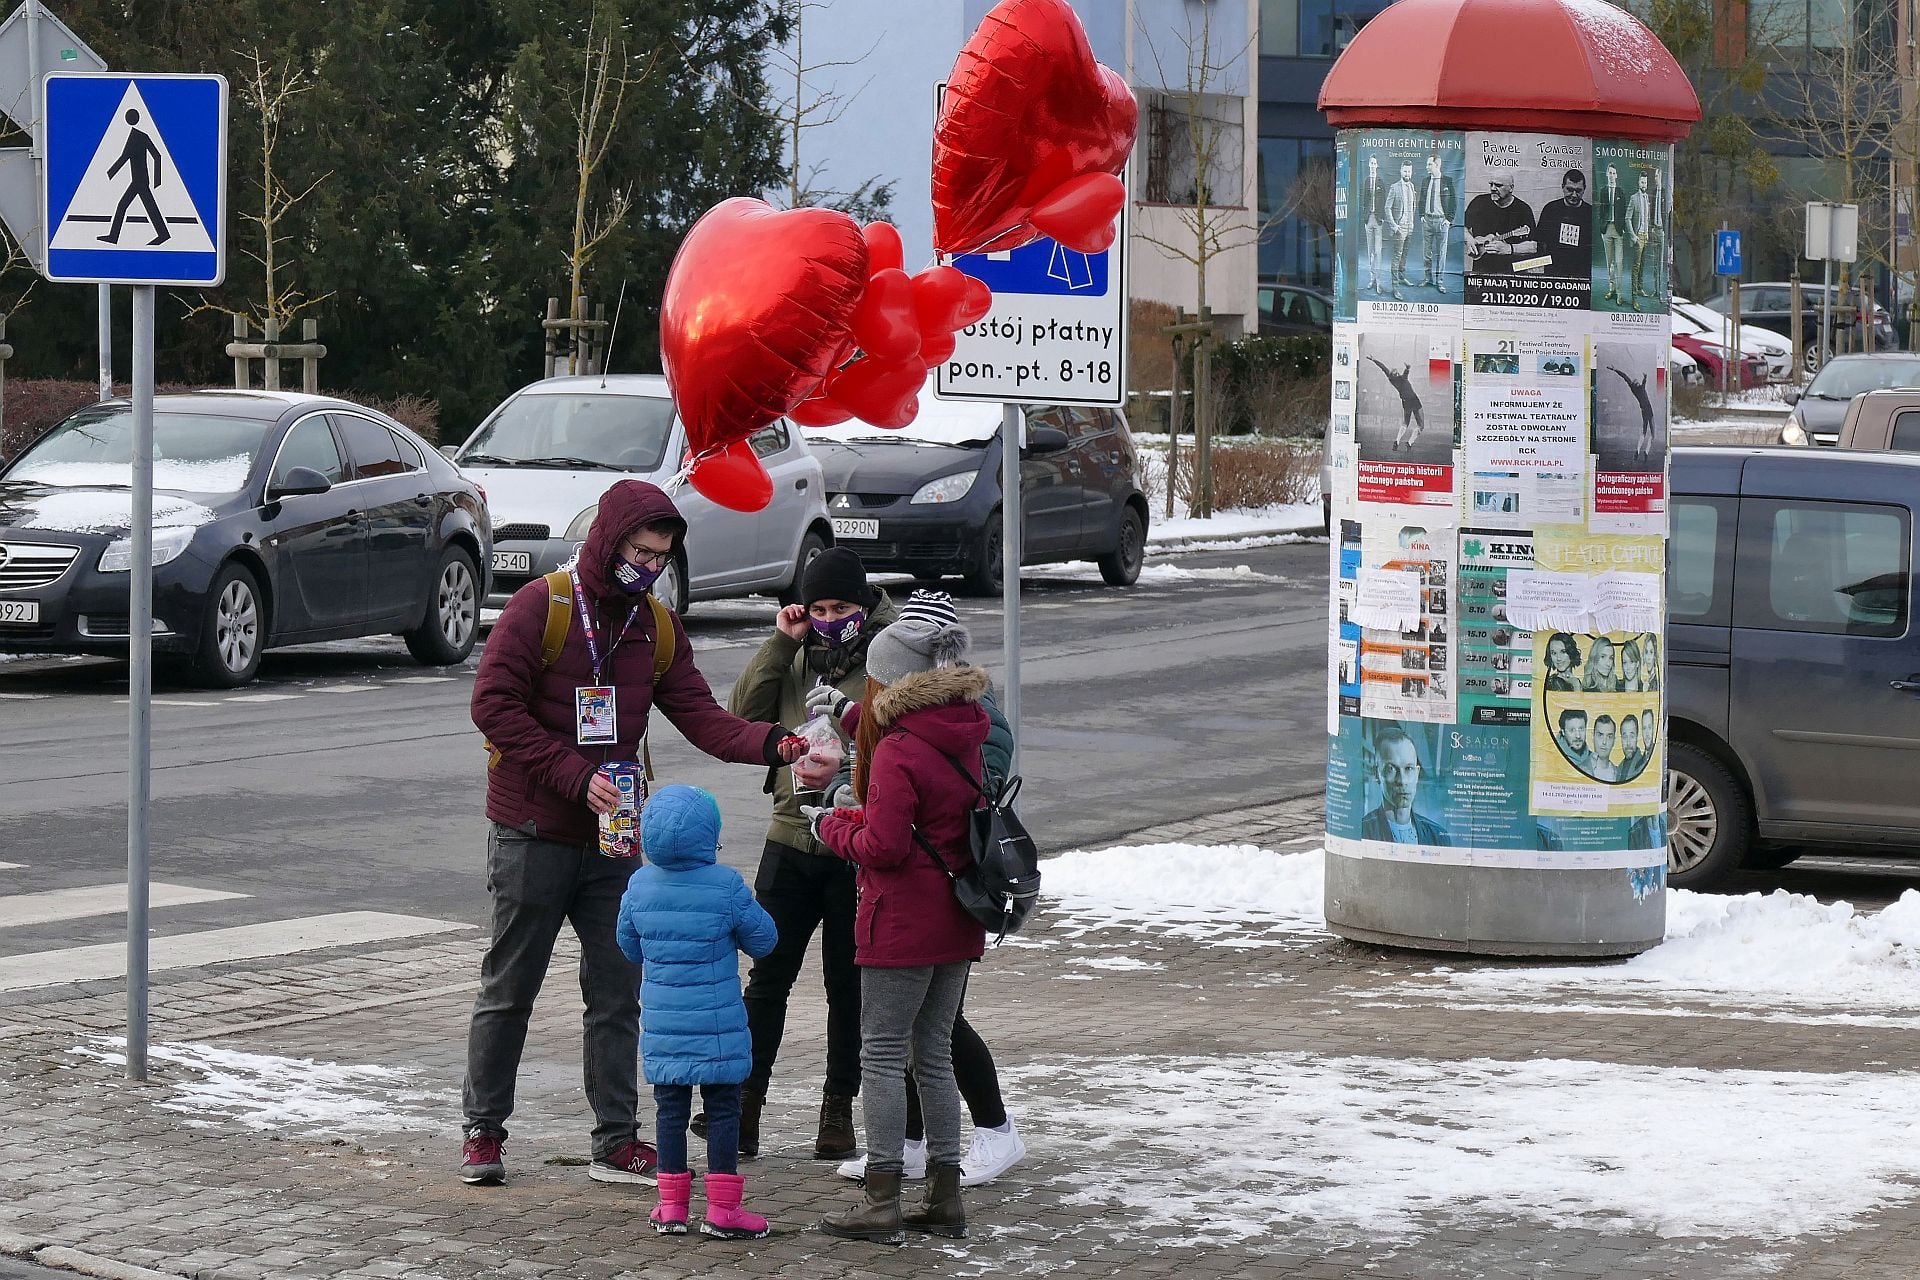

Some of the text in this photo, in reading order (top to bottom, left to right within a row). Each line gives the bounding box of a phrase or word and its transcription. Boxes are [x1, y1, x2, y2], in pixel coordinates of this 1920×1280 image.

[1362, 138, 1461, 149] SMOOTH GENTLEMEN
[1596, 147, 1634, 158] SMOOTH
[1484, 279, 1508, 289] MAJĄ
[1510, 280, 1521, 288] TU
[1524, 281, 1539, 289] NIC
[1540, 281, 1553, 289] DO
[1554, 282, 1590, 291] GADANIA
[1482, 293, 1538, 305] 21.11.2020
[1550, 296, 1579, 306] 19.00
[1417, 304, 1439, 312] 18.00
[1610, 314, 1644, 323] 08.11.2020
[962, 316, 1113, 349] ostój płatny
[1498, 340, 1515, 353] 21
[949, 360, 1112, 386] pon.-pt. 8-18
[1359, 463, 1443, 476] Fotograficzny zapis historii
[1359, 475, 1424, 487] odrodzonego państwa
[1597, 474, 1636, 484] Fotograficzny
[1597, 485, 1634, 496] odrodzonego
[835, 520, 876, 534] 3290N
[492, 554, 527, 569] 9540
[1467, 630, 1487, 638] 15.10
[1466, 736, 1509, 745] SALON
